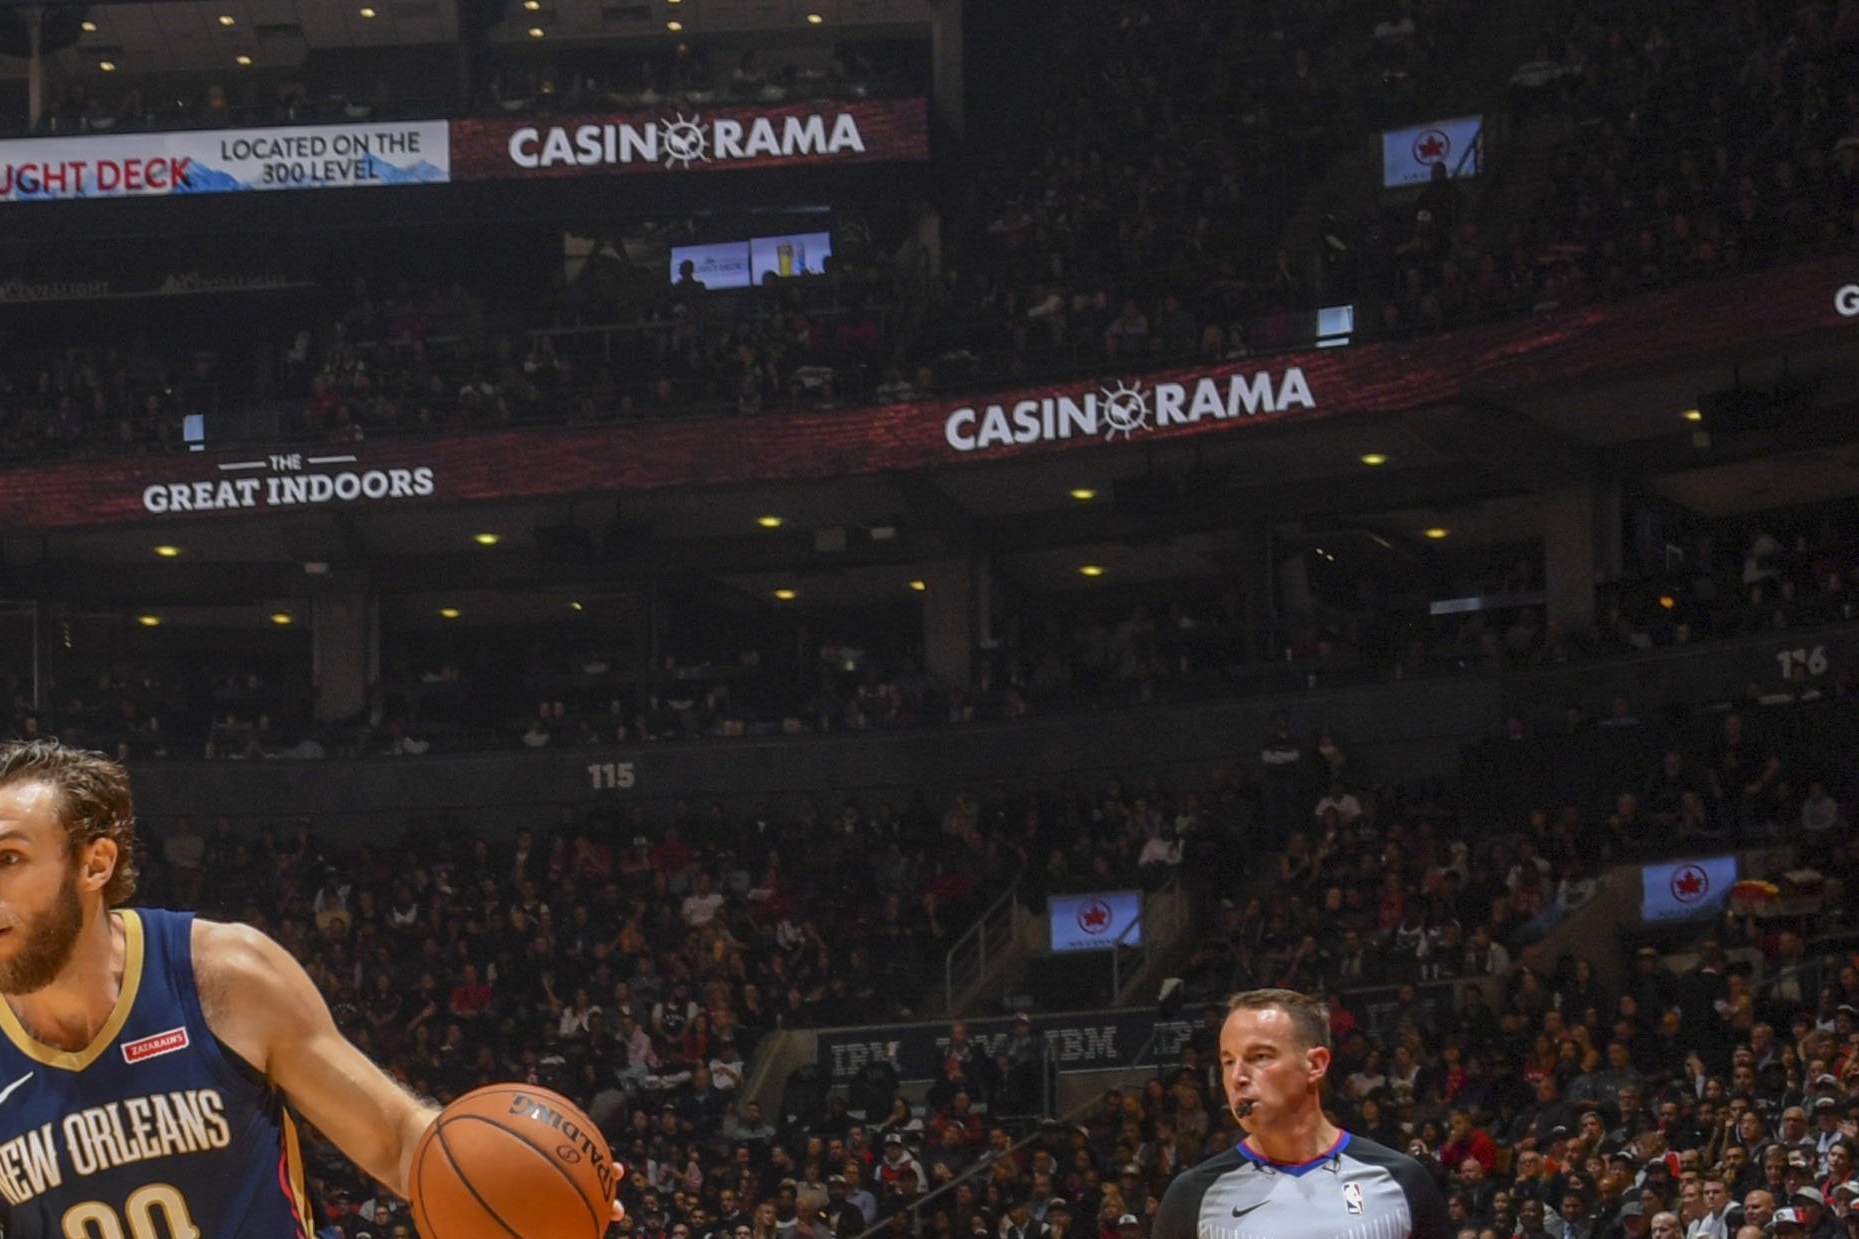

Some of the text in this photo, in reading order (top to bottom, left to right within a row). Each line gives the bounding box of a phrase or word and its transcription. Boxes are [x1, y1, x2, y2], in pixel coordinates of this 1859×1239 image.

[220, 131, 420, 161] LOCATED ON THE
[98, 156, 192, 190] DECK
[262, 157, 380, 184] 300 LEVEL
[270, 455, 302, 470] THE
[143, 467, 434, 513] GREAT INDOORS
[588, 761, 634, 789] 115
[1047, 1026, 1117, 1063] IBM
[61, 1088, 231, 1176] ORLEANS
[509, 1093, 614, 1203] PALDING
